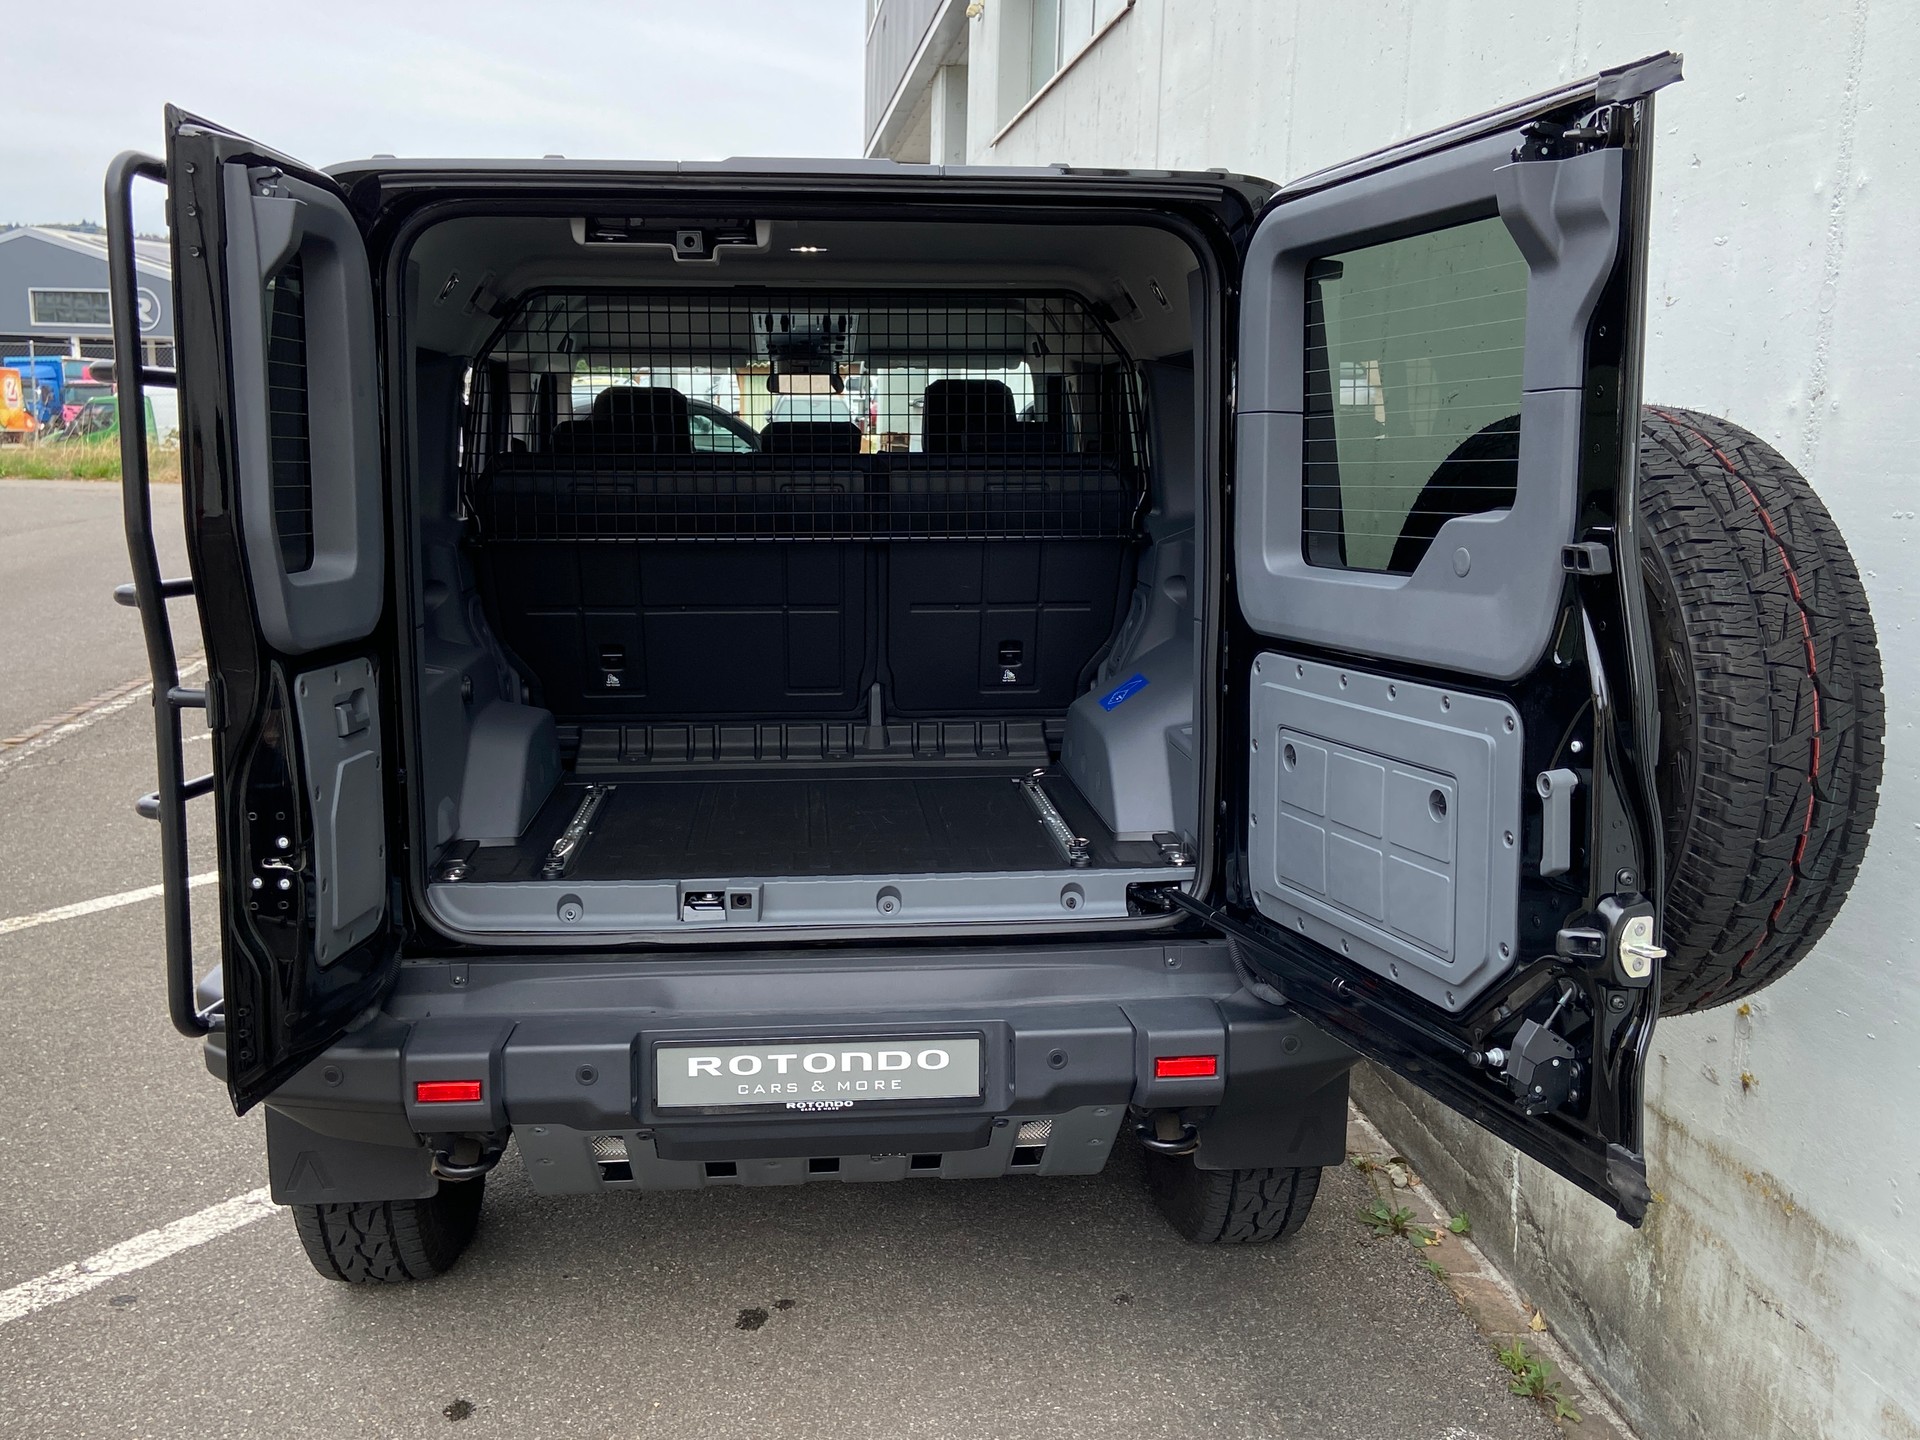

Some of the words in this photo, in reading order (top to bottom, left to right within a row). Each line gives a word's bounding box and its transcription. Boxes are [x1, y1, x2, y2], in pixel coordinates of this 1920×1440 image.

[737, 1083, 798, 1095] CARS
[811, 1080, 826, 1092] &
[837, 1079, 902, 1091] MORE
